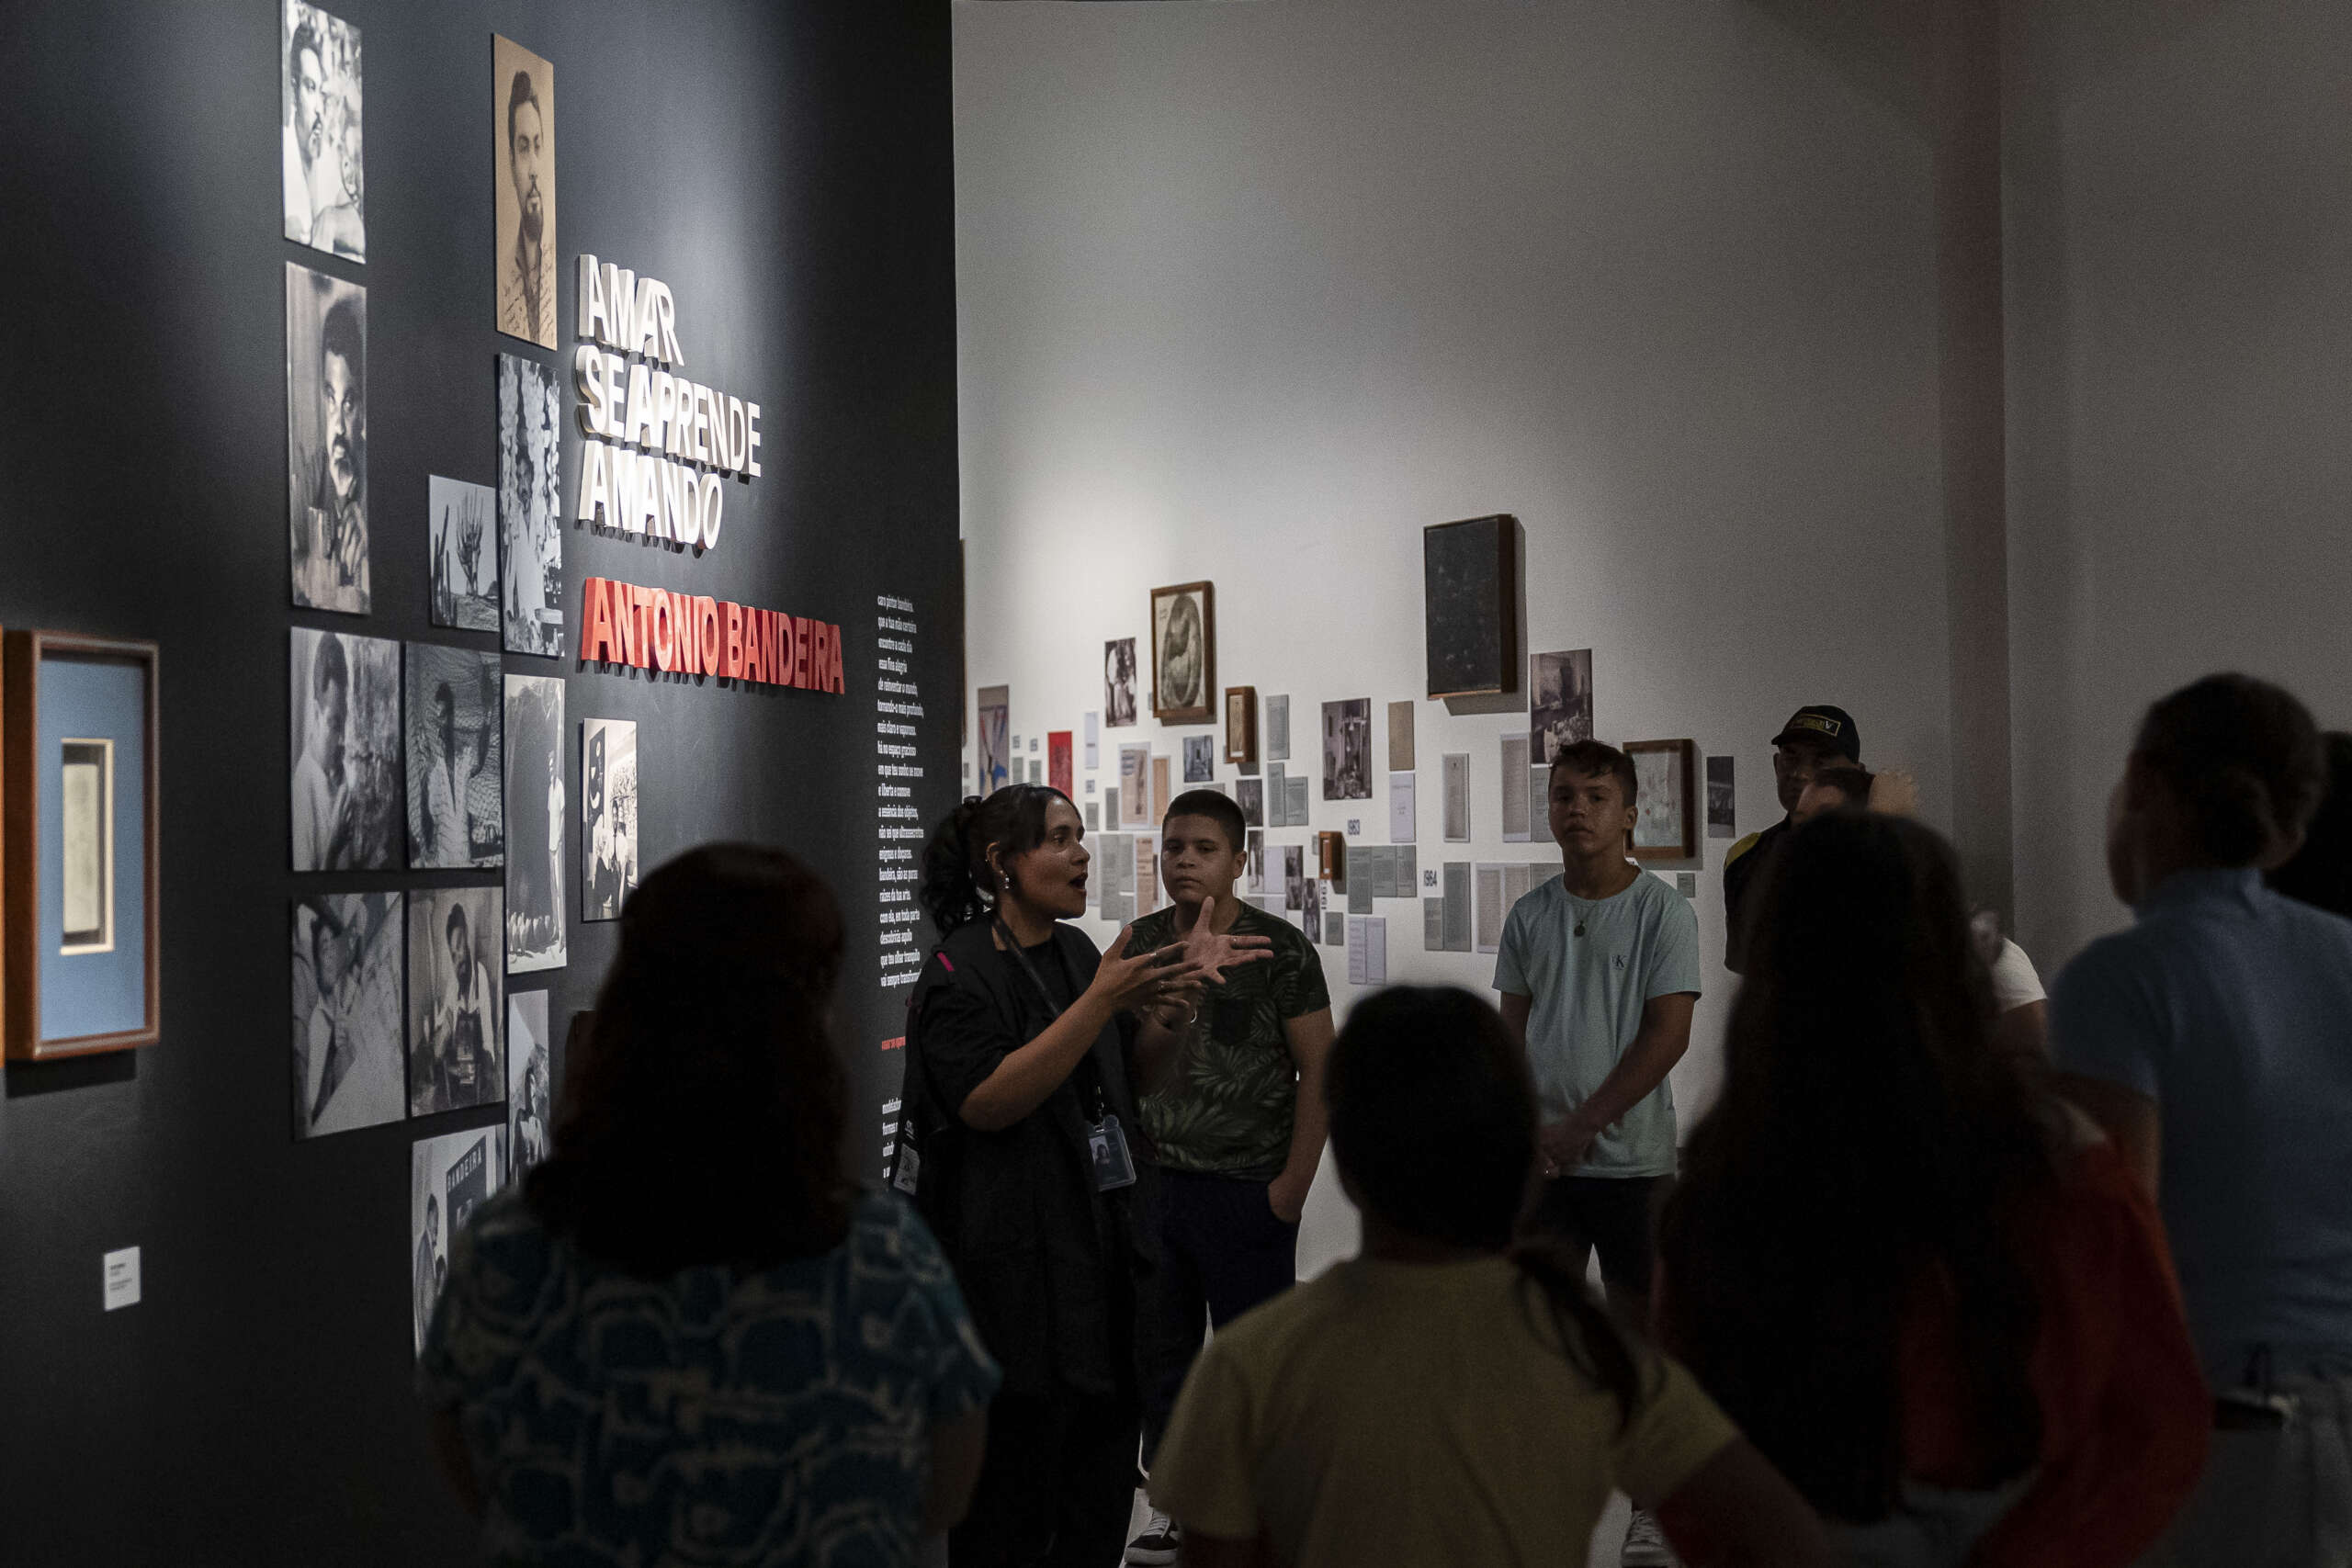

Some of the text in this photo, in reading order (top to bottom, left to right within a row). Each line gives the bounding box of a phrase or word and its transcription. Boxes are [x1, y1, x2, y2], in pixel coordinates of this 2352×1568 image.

[580, 254, 684, 366] AMAR
[576, 344, 761, 478] SE APRENDE
[579, 440, 723, 550] AMANDO
[582, 577, 844, 694] ANTONIO BANDEIRA
[447, 1145, 482, 1193] BANDEIRA
